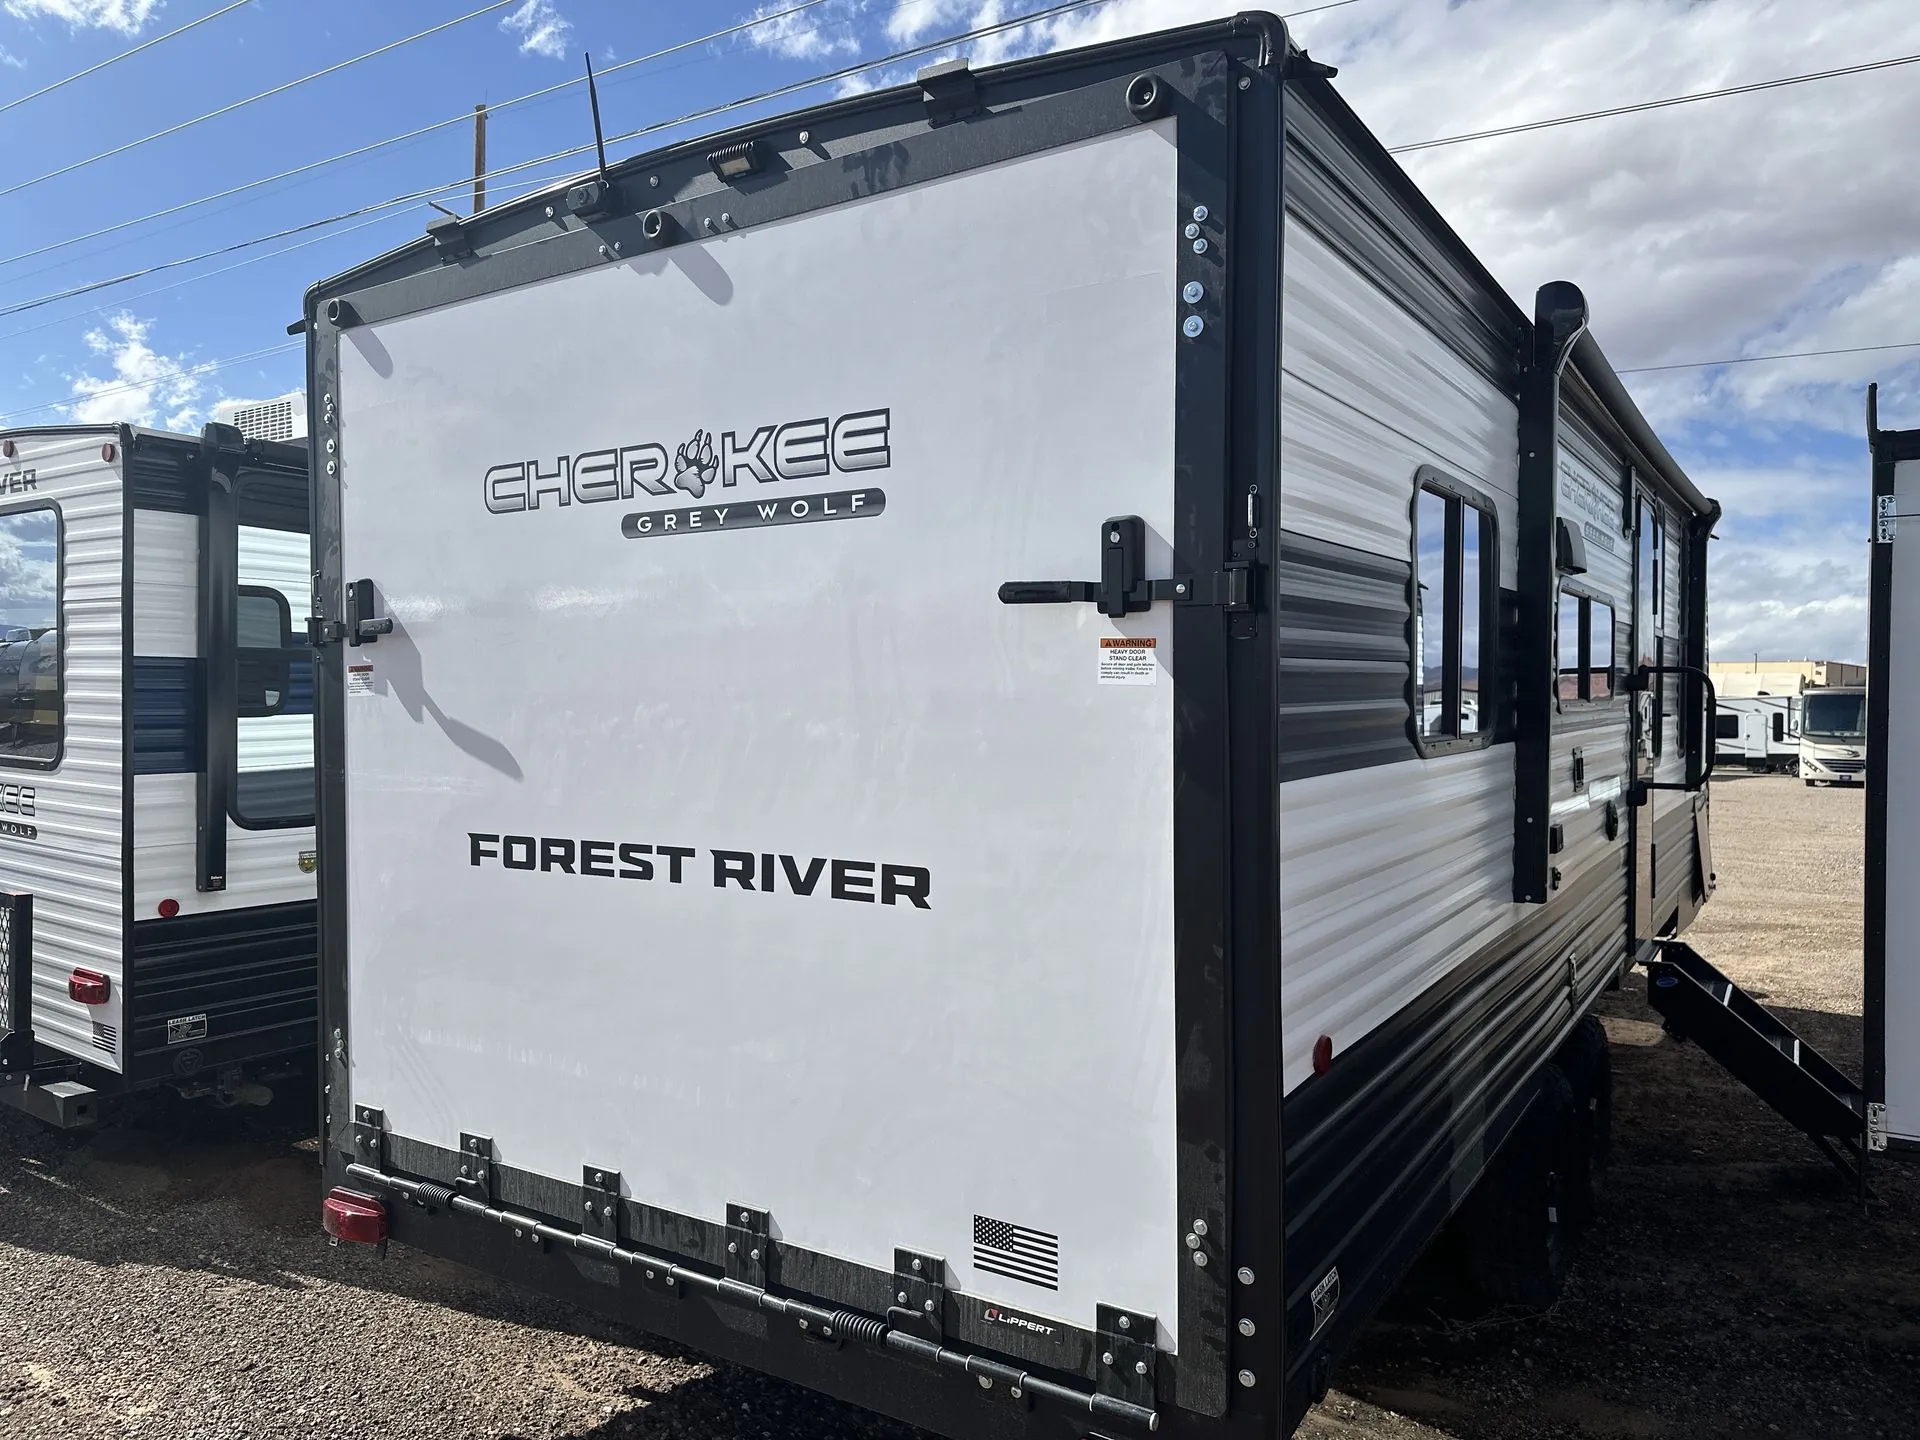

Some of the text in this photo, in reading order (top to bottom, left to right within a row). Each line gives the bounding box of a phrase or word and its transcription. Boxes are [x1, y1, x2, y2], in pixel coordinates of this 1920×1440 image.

[636, 493, 867, 533] GREY WOLF
[1113, 639, 1152, 647] WARNING
[1, 823, 32, 836] WOLF
[467, 832, 932, 910] FOREST RIVER
